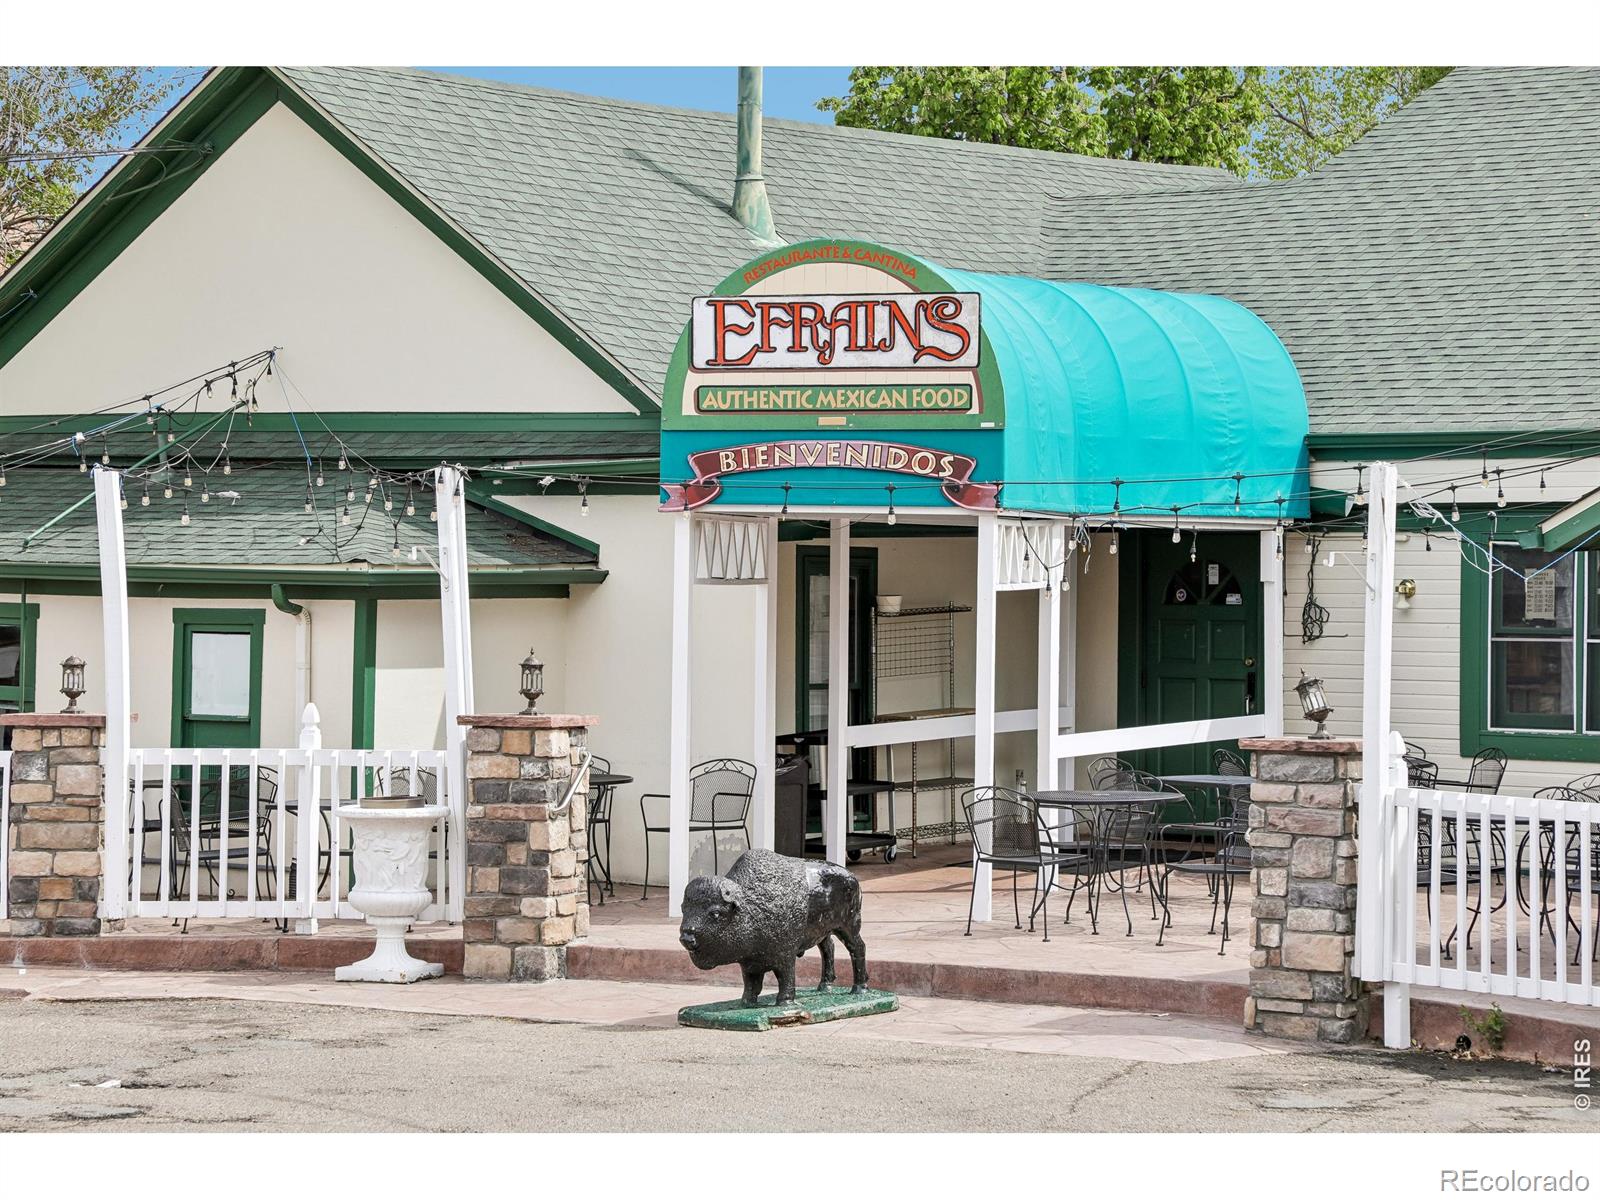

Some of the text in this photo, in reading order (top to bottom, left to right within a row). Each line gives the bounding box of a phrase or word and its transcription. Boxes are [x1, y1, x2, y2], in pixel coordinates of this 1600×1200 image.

[743, 246, 918, 285] RESTAURANTE & CANTINA
[702, 387, 969, 410] AUTHENTIC MEXICAN FOOD
[718, 442, 955, 478] BIENVENIDOS
